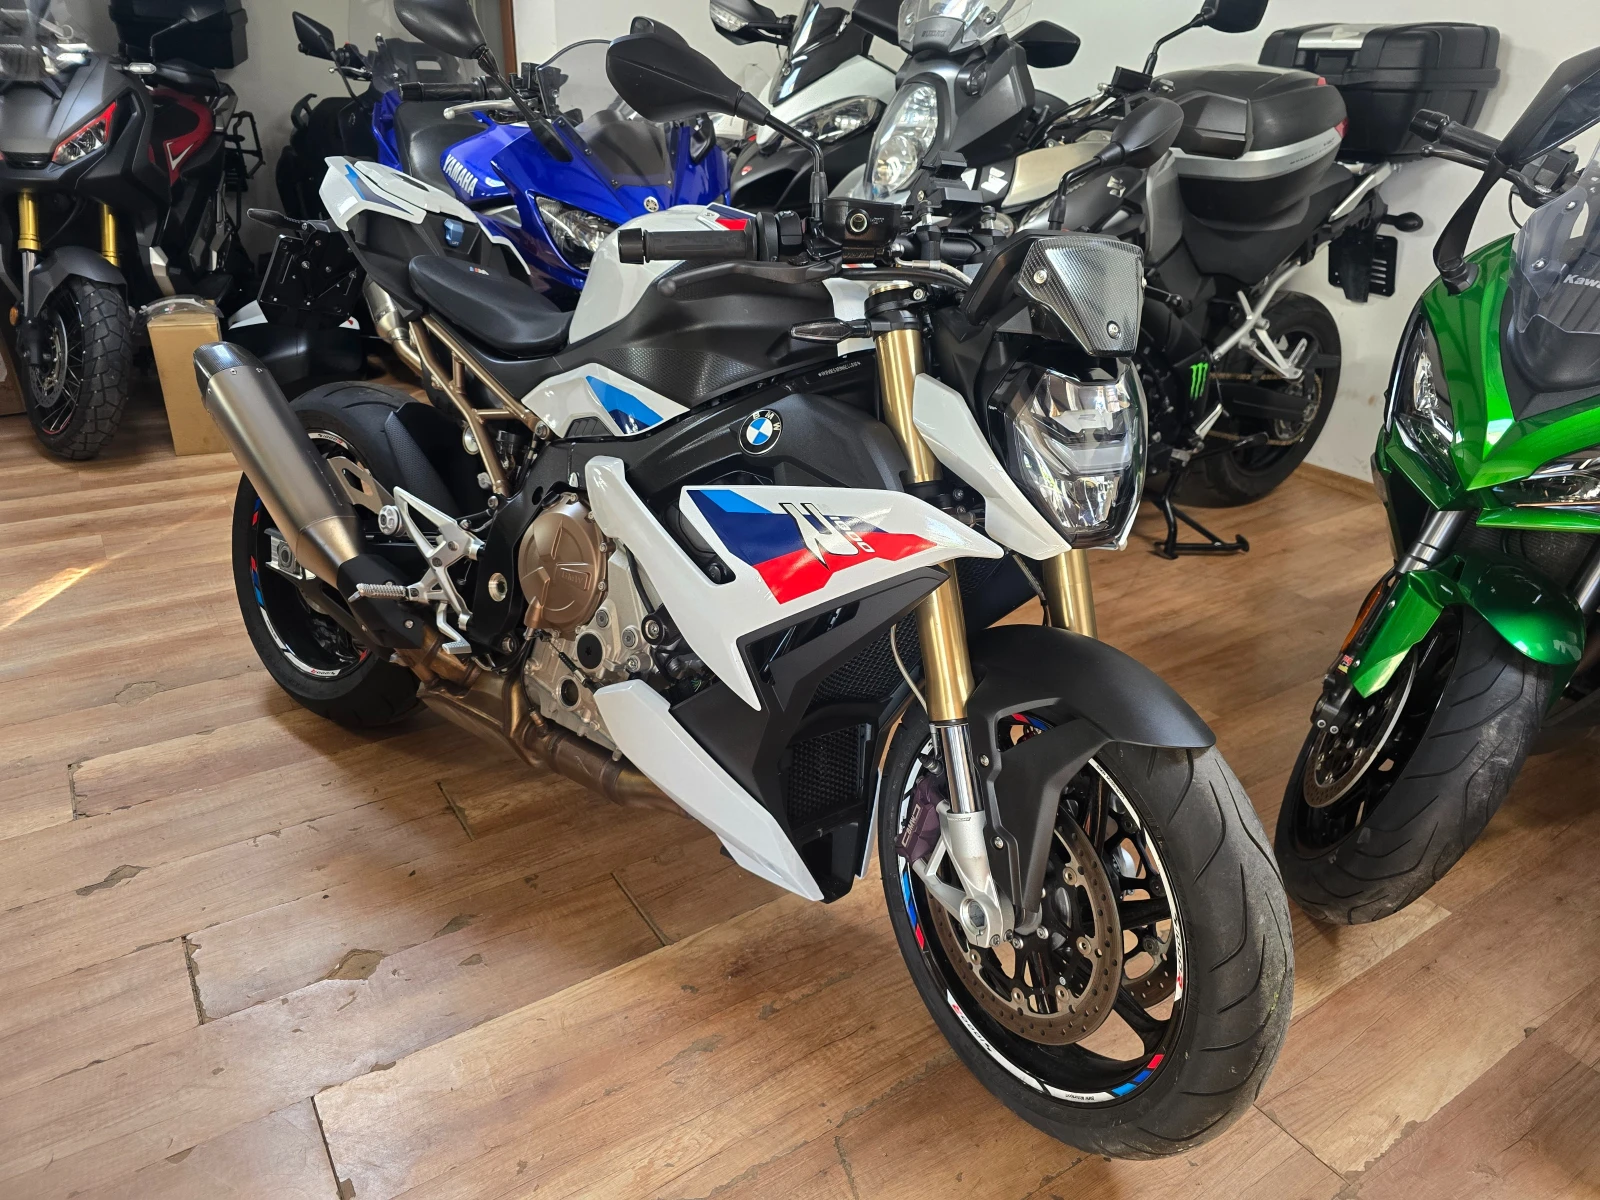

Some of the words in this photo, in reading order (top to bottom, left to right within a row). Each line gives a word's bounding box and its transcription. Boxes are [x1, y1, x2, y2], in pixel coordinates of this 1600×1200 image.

[443, 153, 479, 197] YAMAHA
[752, 411, 781, 431] BMW
[906, 814, 918, 835] BMW
